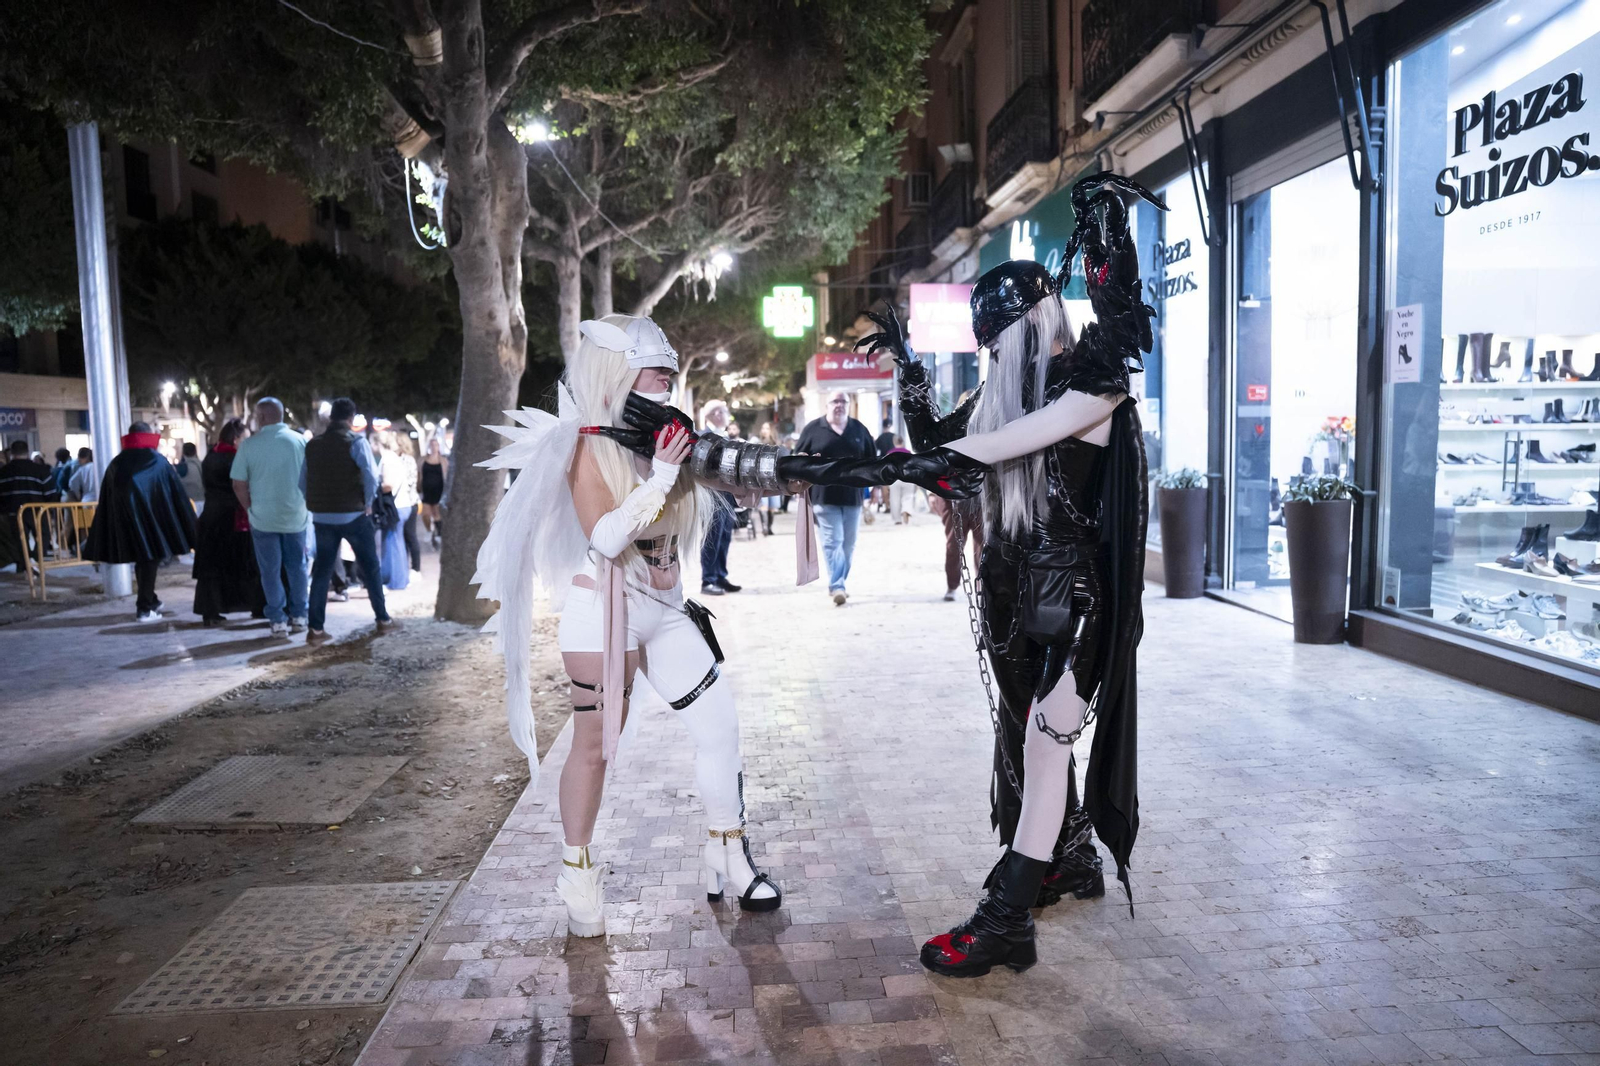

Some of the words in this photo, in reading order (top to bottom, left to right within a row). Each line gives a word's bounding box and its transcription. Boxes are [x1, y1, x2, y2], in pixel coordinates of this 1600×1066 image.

[1451, 71, 1588, 159] Plaza
[1434, 132, 1600, 217] Suizos.
[1479, 218, 1513, 235] DESDE
[1518, 210, 1541, 225] 1917
[1152, 238, 1192, 271] Plaza
[1396, 309, 1415, 319] Noche
[1401, 321, 1409, 329] en
[1396, 330, 1414, 340] Negro
